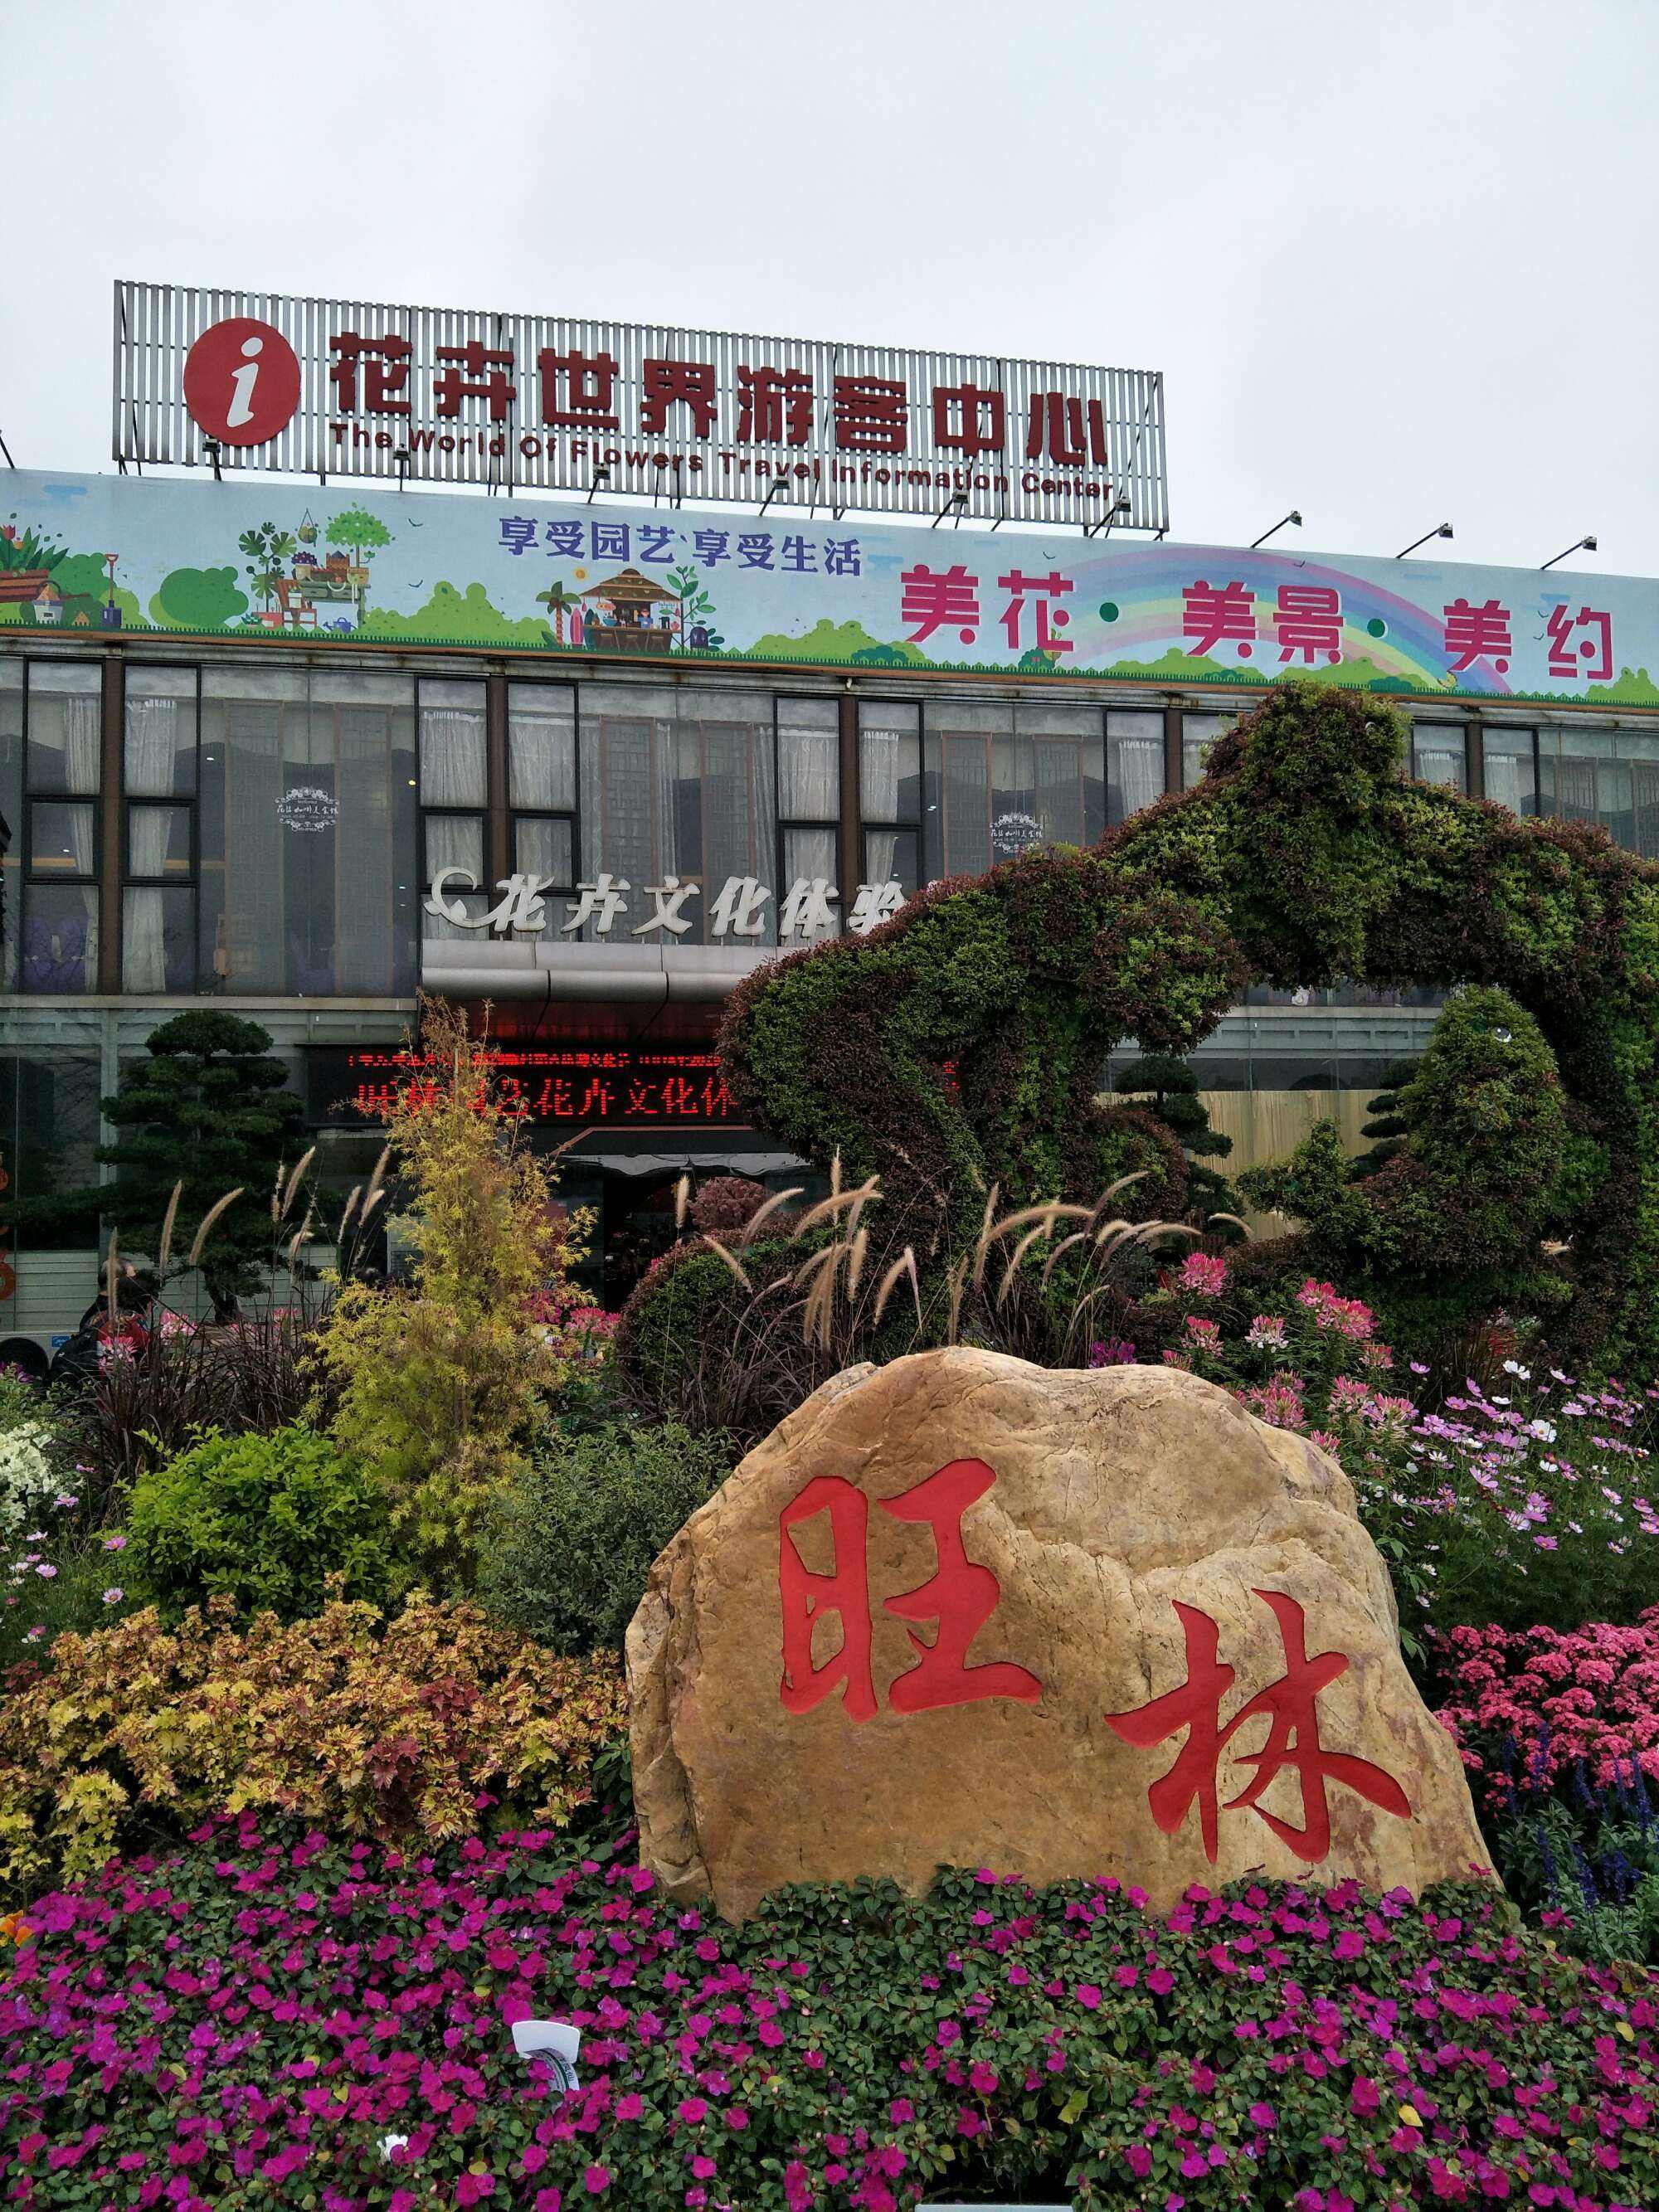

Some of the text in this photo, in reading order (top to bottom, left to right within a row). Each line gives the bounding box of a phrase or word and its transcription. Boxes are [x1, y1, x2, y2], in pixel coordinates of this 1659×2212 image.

[329, 332, 1108, 467] 花卉世界游客中心
[329, 422, 1114, 500] The World Of Flowers Travel Information Center
[779, 1456, 1413, 1864] 旺林
